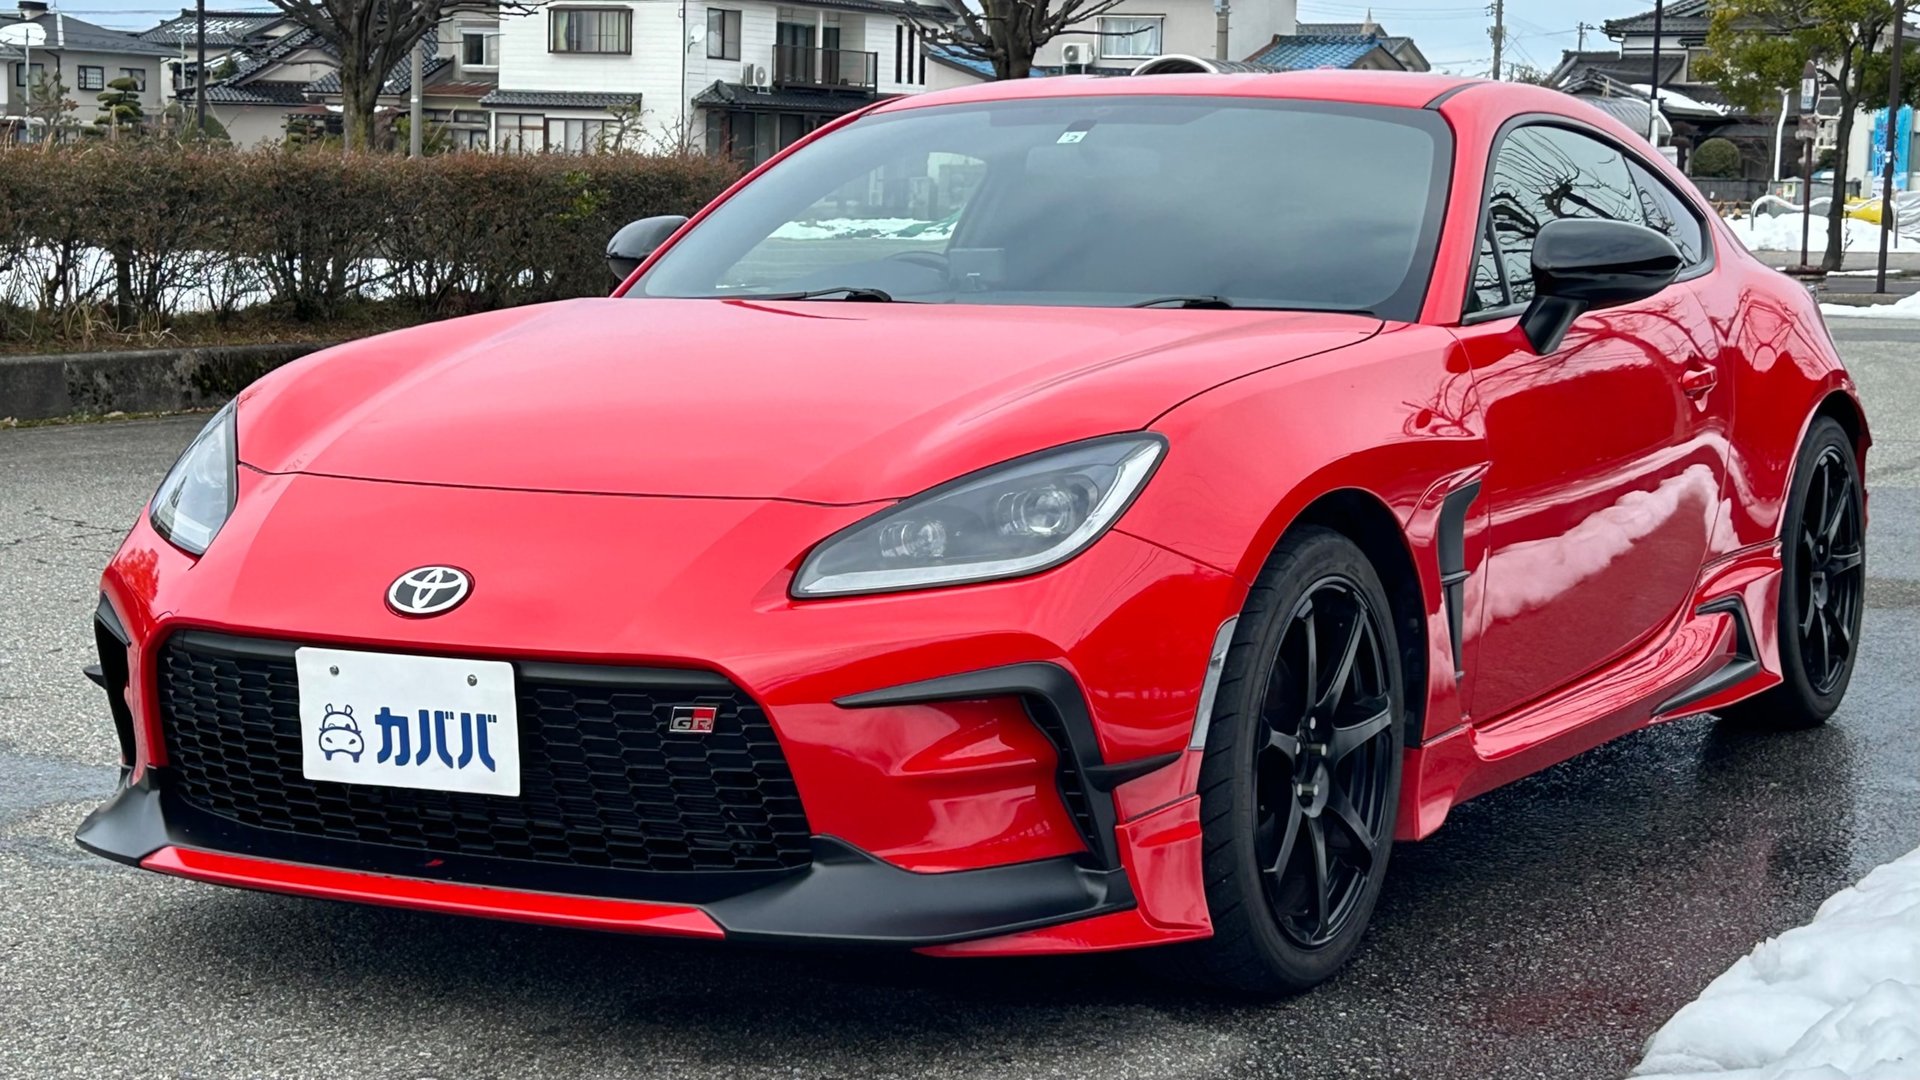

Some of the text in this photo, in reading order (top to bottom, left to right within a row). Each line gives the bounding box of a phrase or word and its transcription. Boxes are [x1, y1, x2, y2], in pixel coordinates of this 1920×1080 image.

[374, 706, 498, 773] カババ
[672, 717, 712, 730] GR
